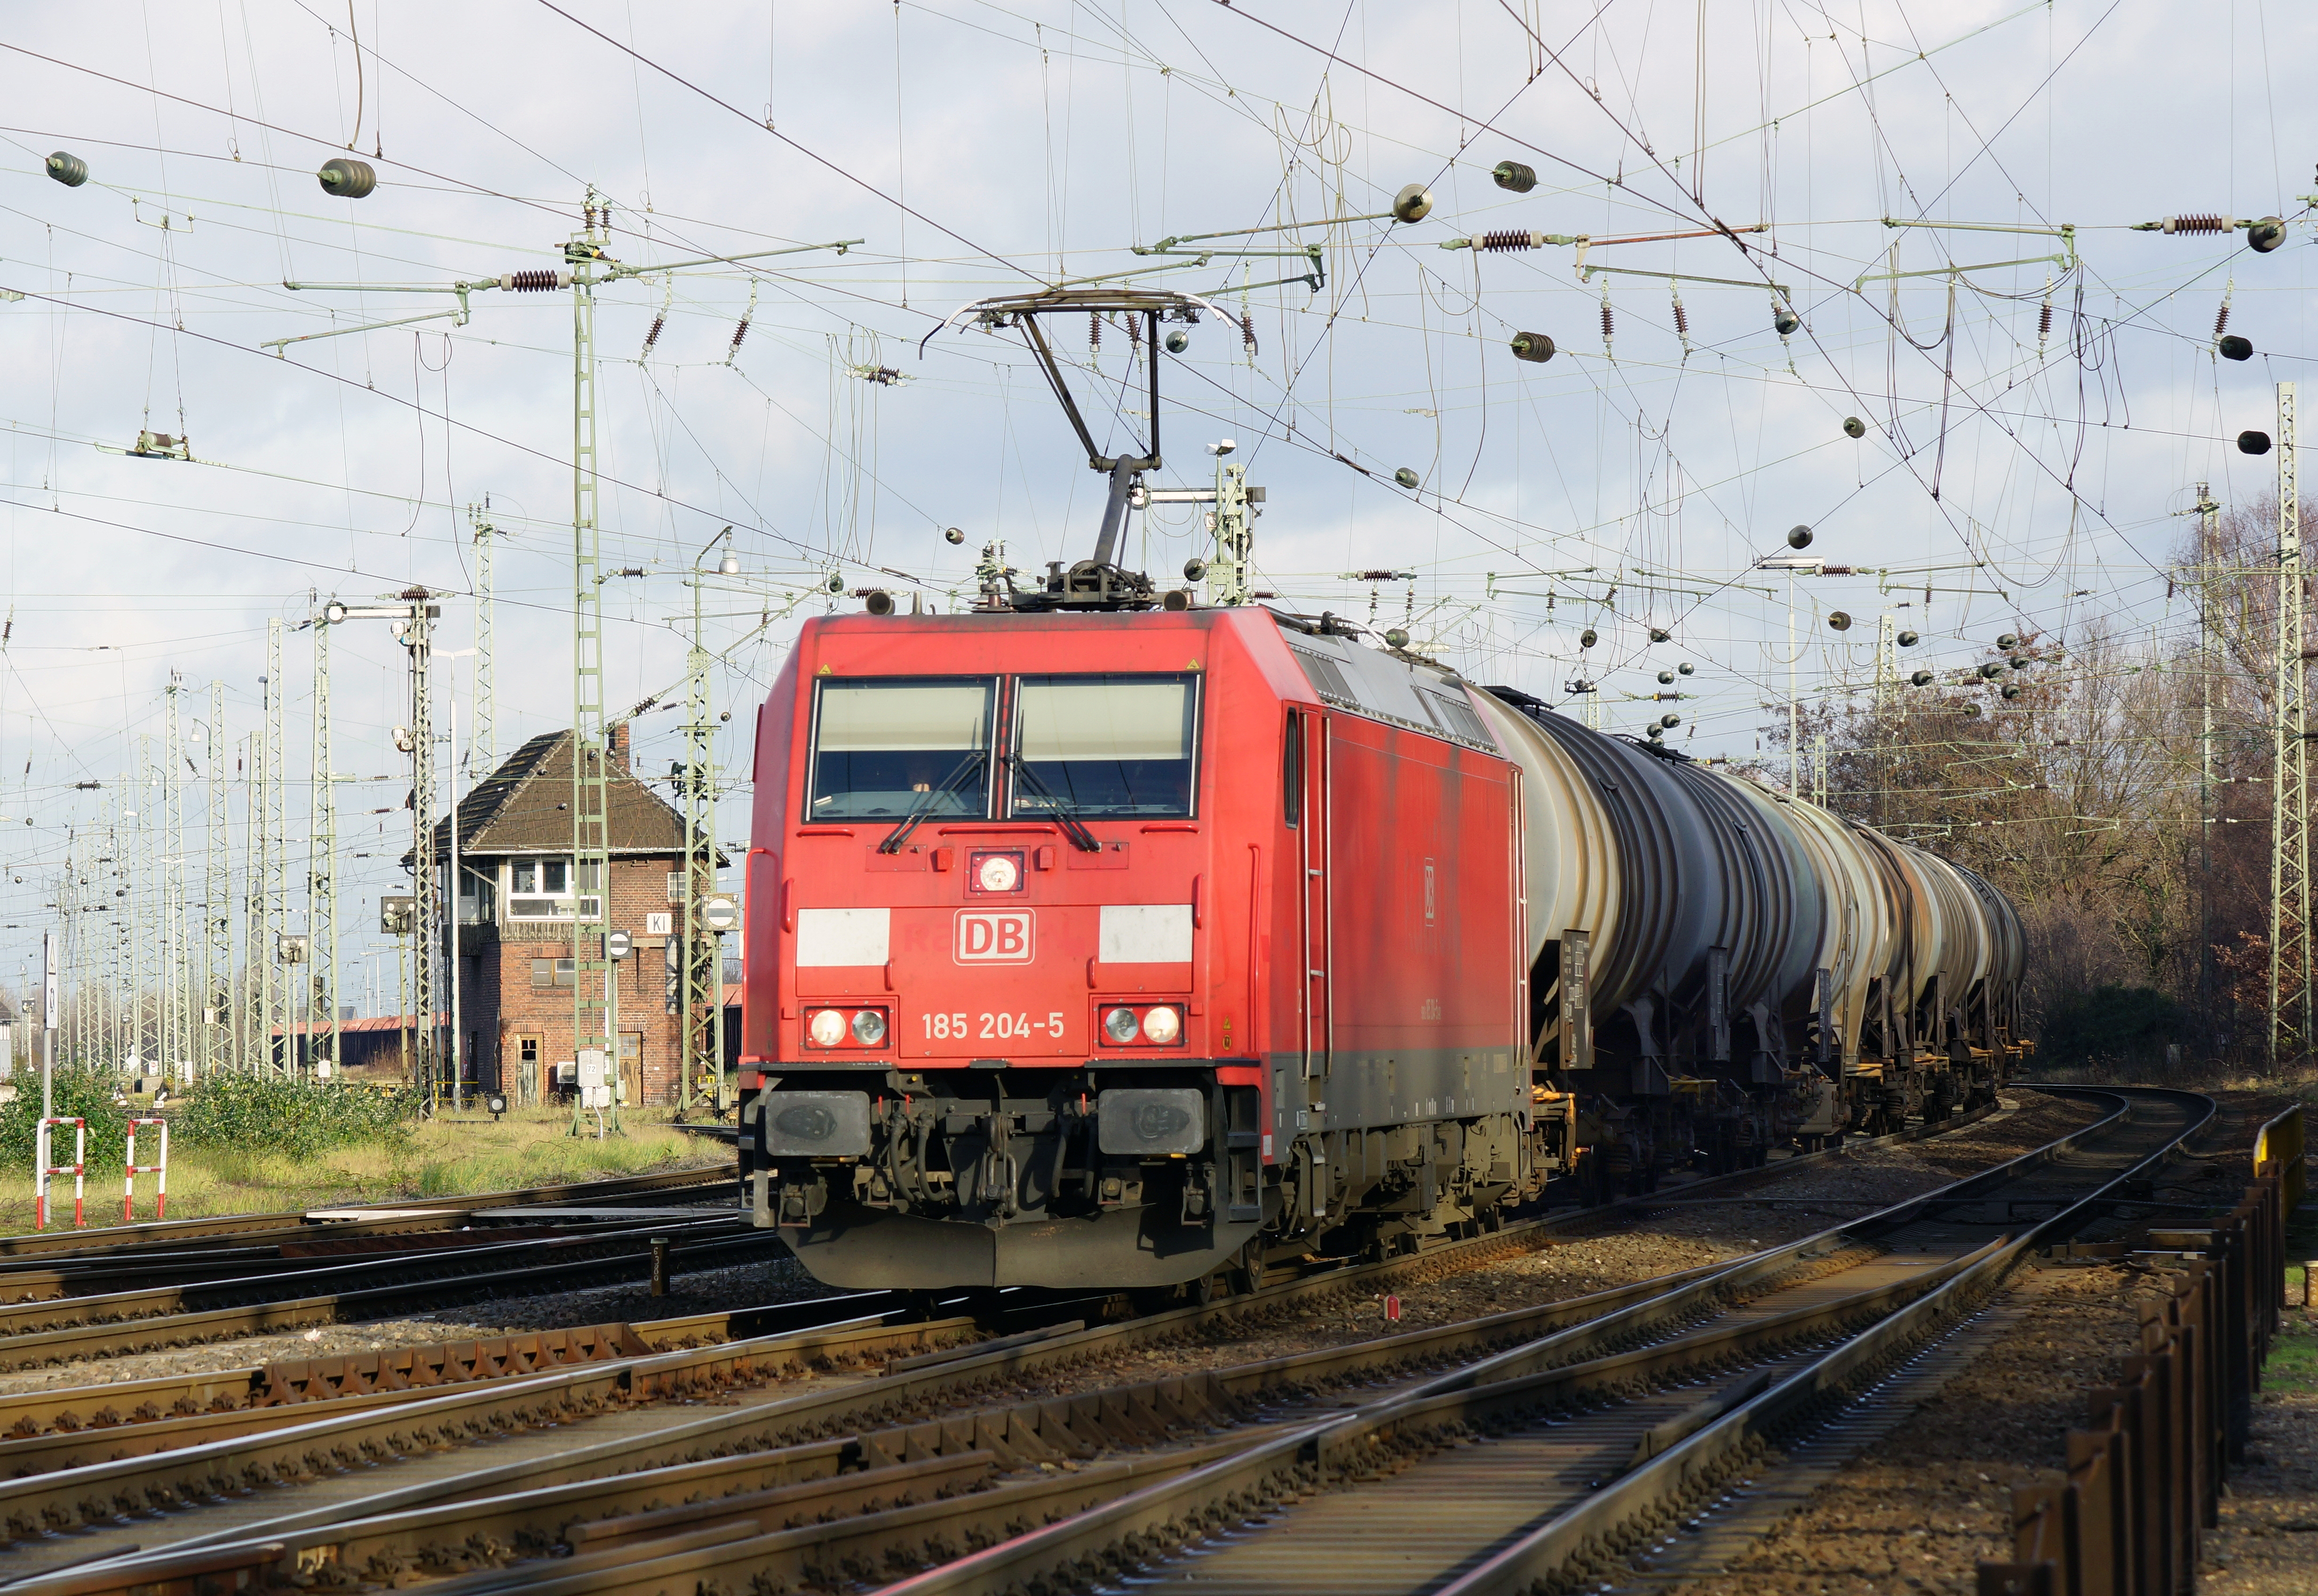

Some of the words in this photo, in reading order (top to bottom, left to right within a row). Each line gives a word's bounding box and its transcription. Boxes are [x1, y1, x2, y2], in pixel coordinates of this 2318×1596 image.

[965, 918, 1024, 954] DB
[922, 1013, 967, 1039] 185
[980, 1012, 1064, 1038] 204-5
